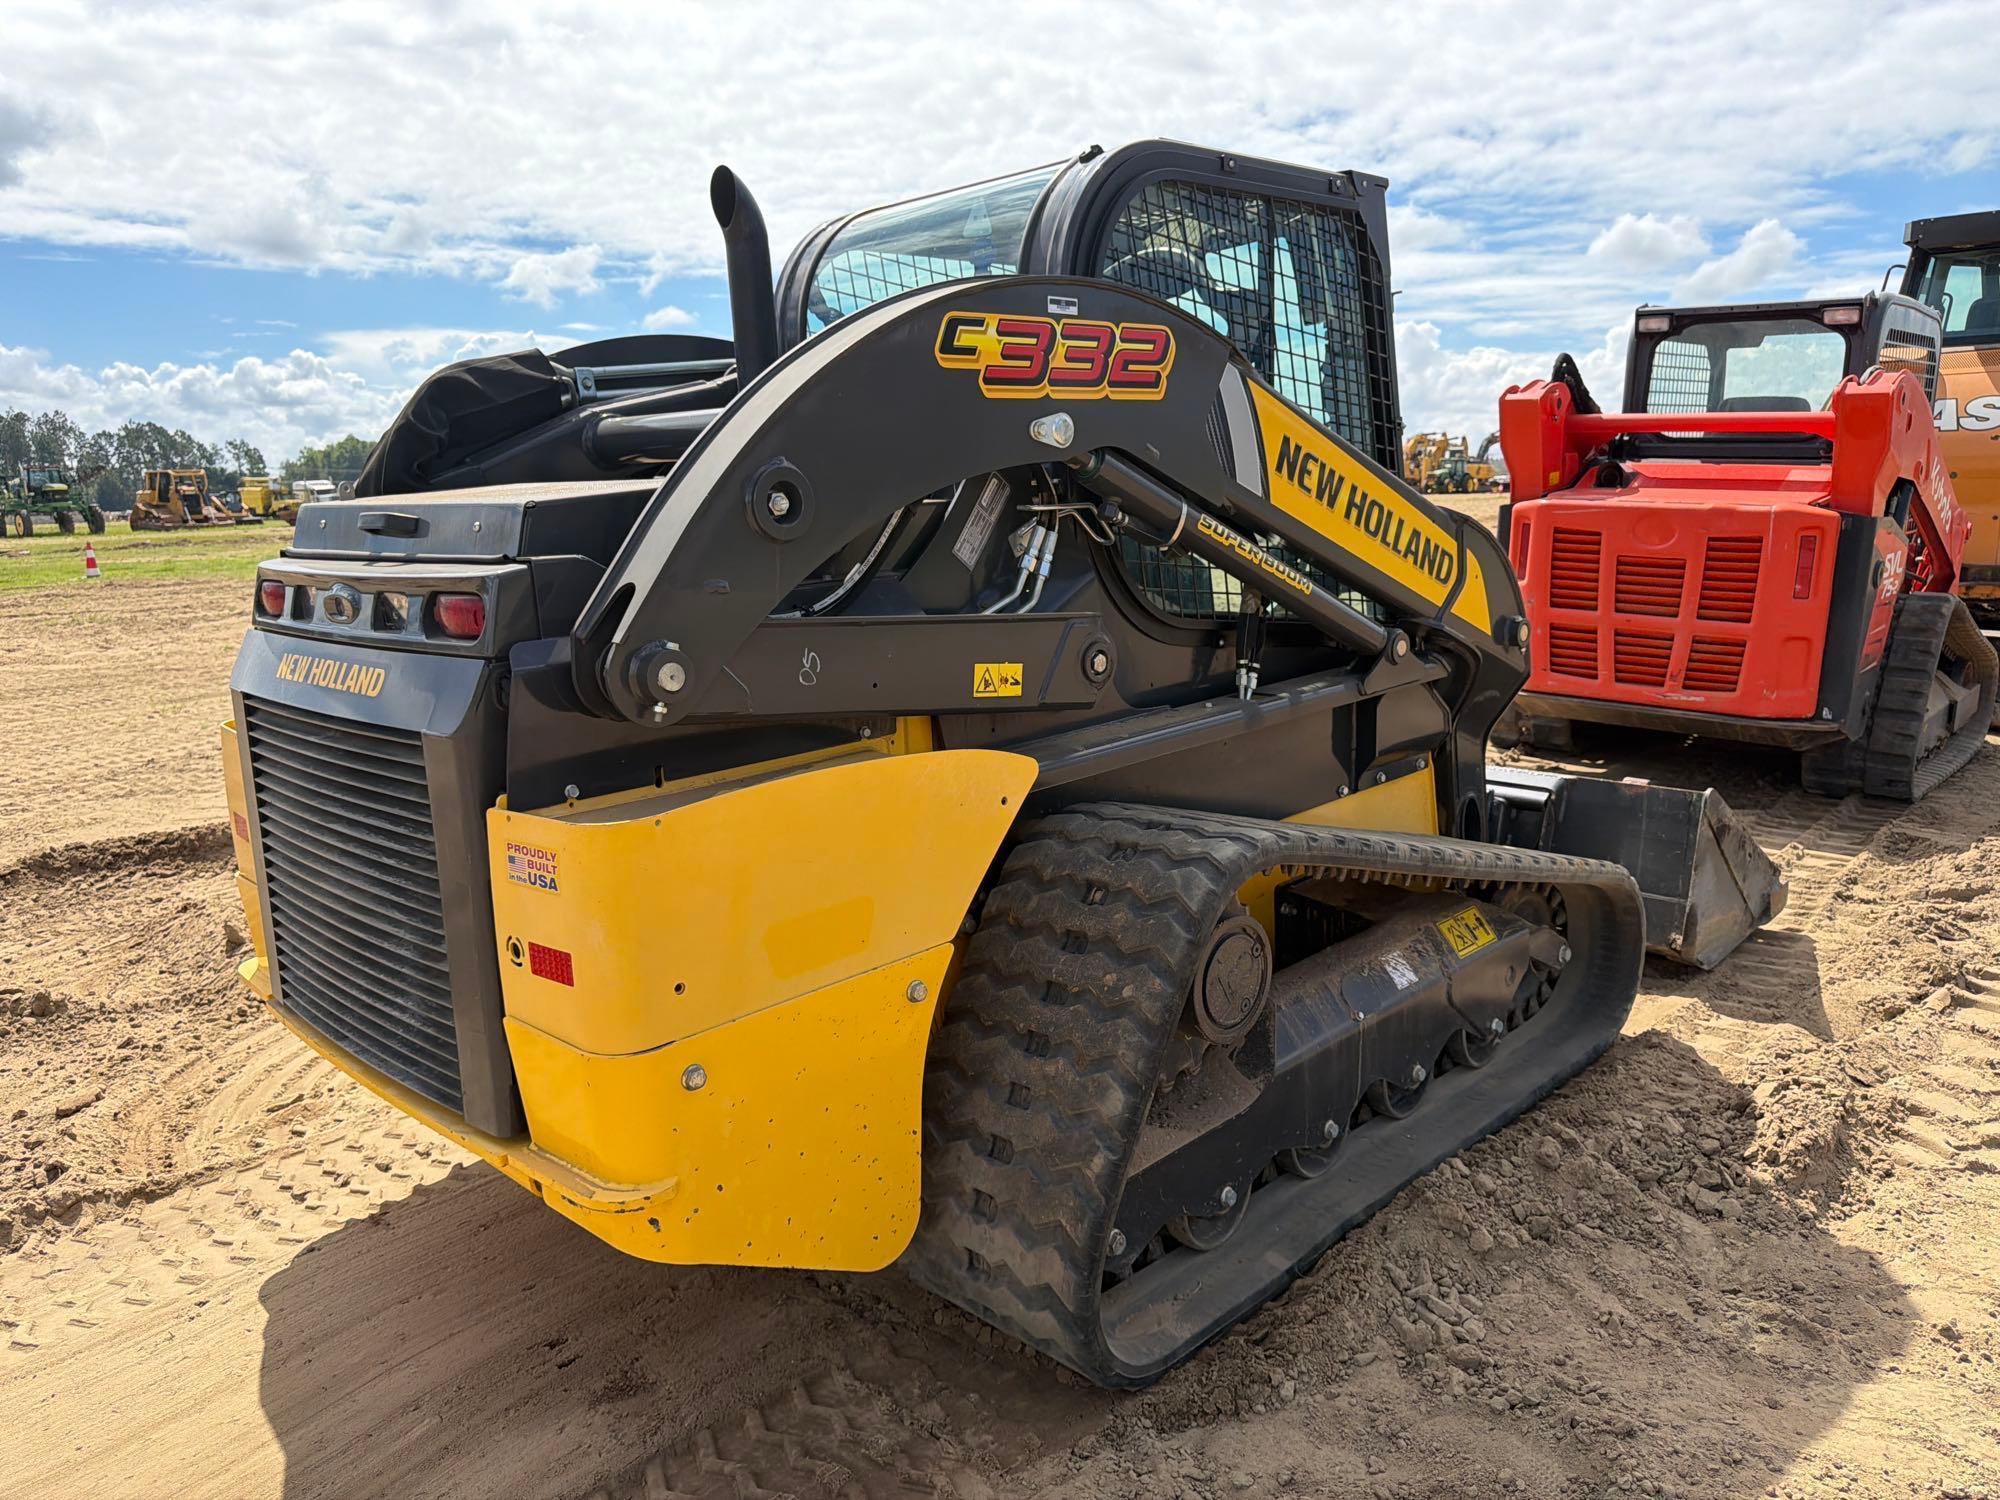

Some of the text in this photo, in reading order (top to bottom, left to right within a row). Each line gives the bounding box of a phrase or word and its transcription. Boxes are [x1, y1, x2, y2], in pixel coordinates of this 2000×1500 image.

[1932, 394, 2000, 432] AS
[1275, 434, 1454, 586] NEW HOLLAND
[1930, 456, 1952, 533] Kubota
[1883, 550, 1904, 578] SVL
[276, 653, 386, 698] NEW HOLLAND
[507, 842, 557, 864] PROUDLY
[527, 859, 557, 876] BUILT
[515, 873, 528, 884] the
[528, 871, 558, 892] USA
